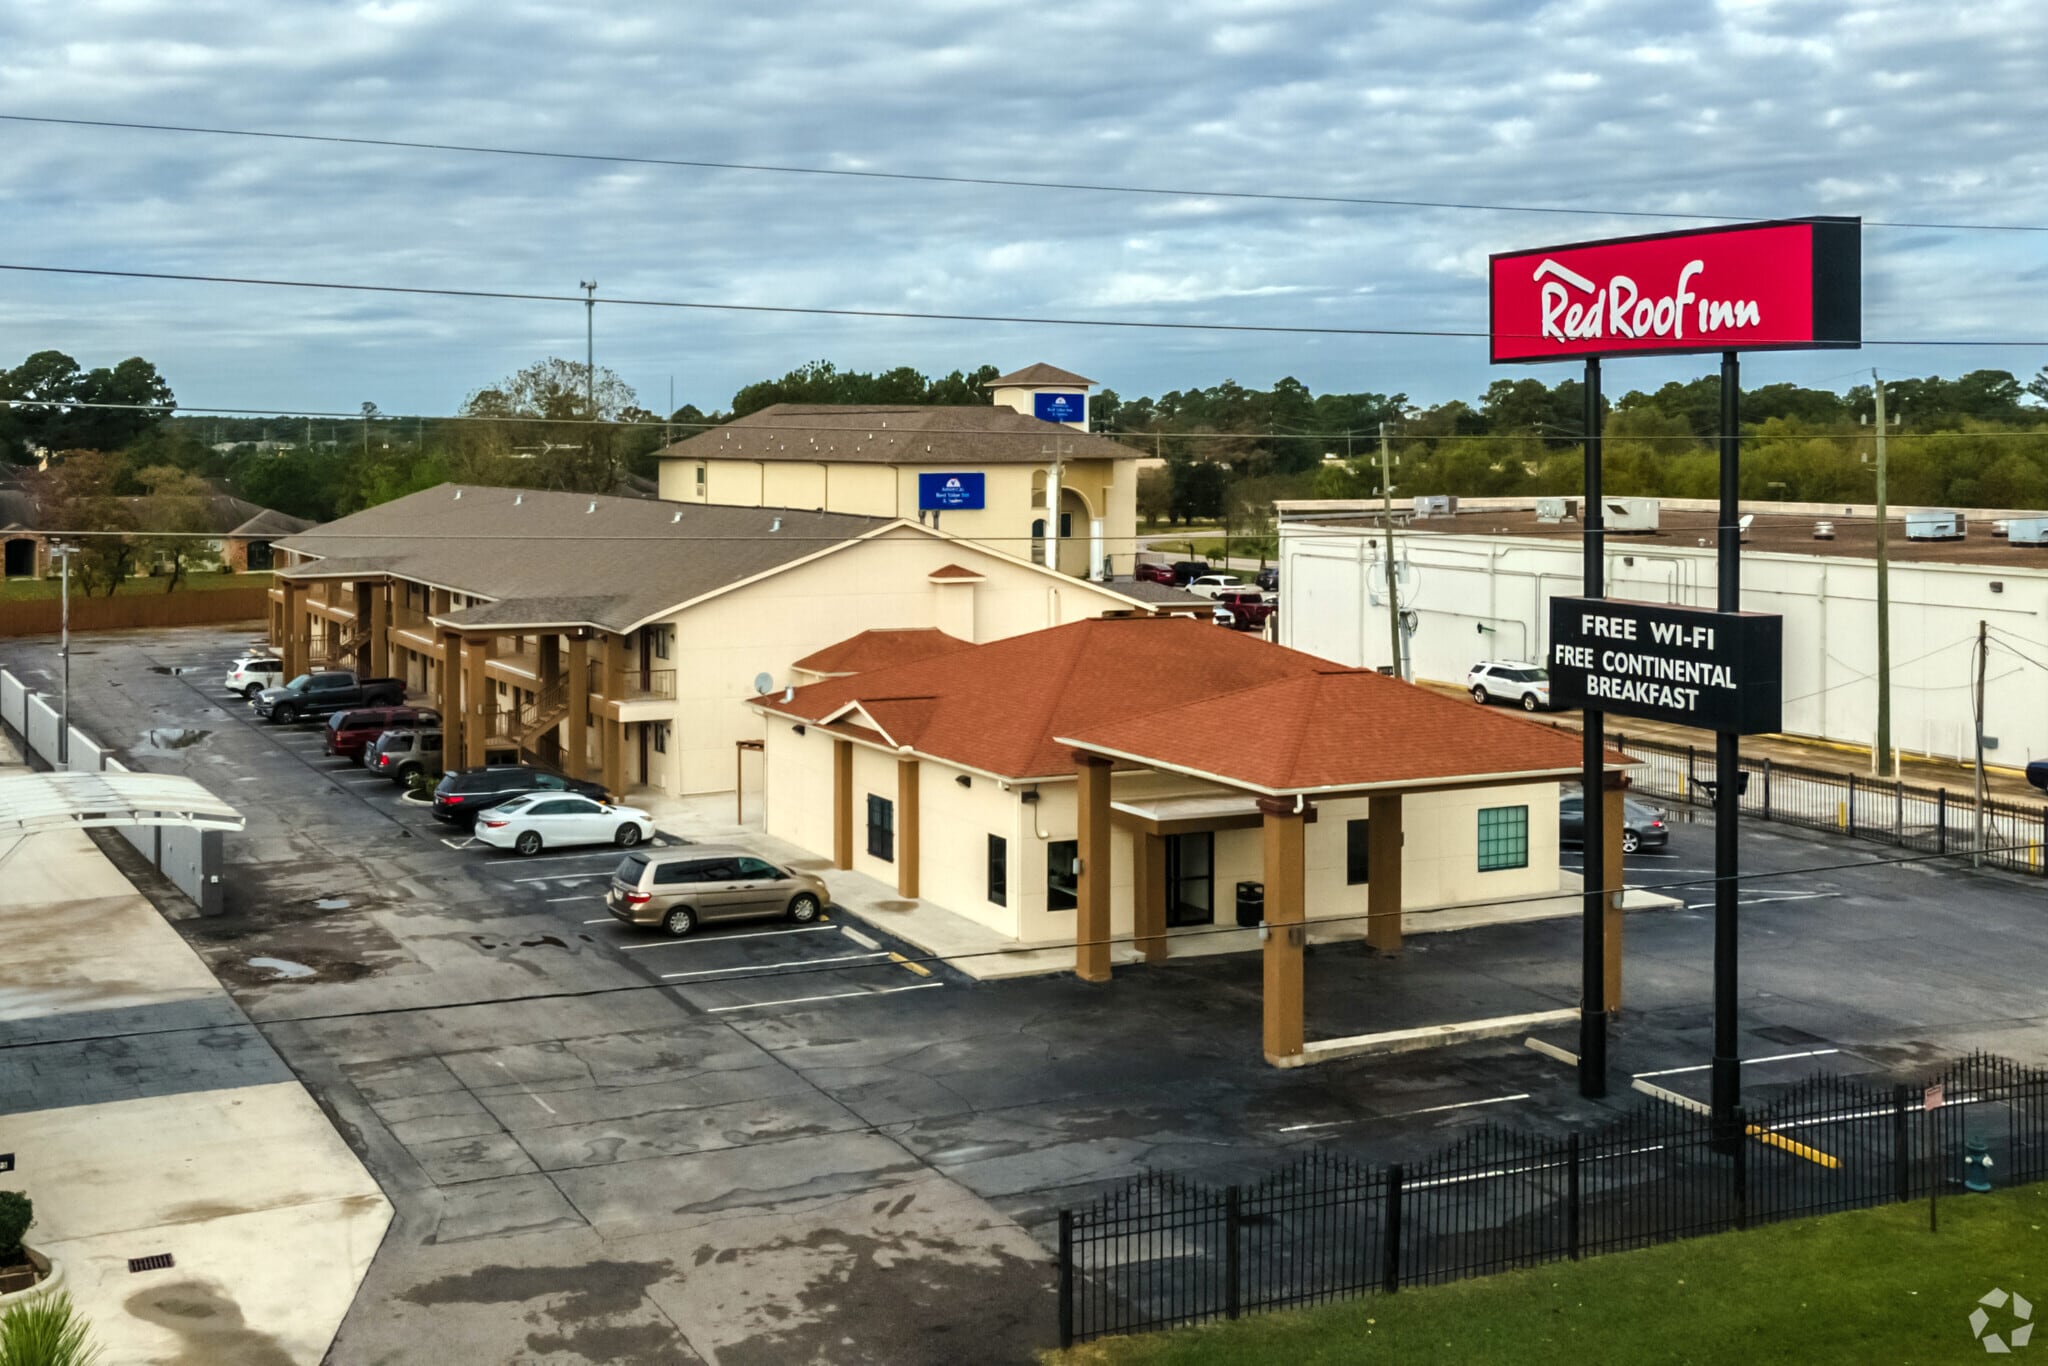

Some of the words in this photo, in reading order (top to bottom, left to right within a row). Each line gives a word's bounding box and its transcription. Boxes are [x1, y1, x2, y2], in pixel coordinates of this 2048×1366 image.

[1581, 614, 1637, 641] FREE
[1649, 621, 1715, 651] WI-FI
[1555, 643, 1594, 669] FREE
[1602, 650, 1737, 690] CONTINENTAL
[1586, 674, 1700, 711] BREAKFAST
